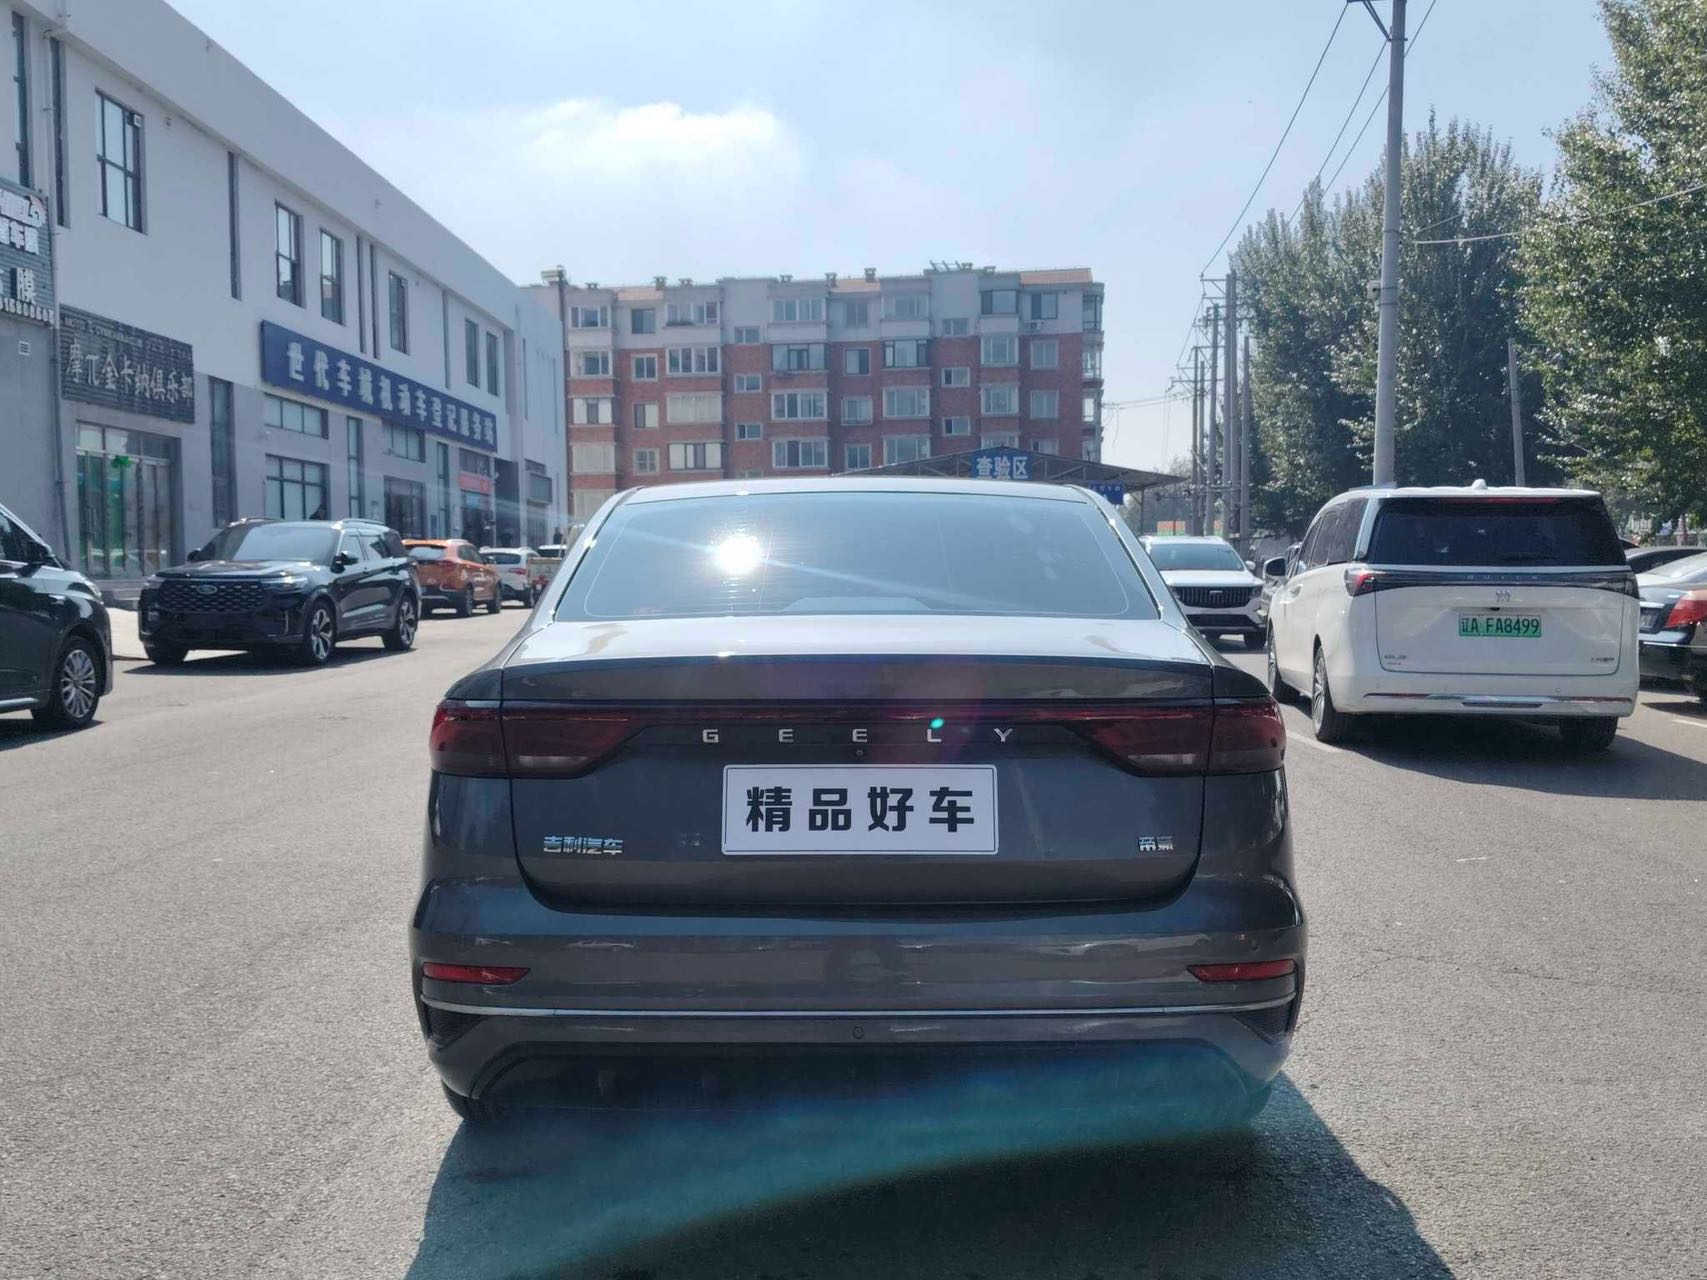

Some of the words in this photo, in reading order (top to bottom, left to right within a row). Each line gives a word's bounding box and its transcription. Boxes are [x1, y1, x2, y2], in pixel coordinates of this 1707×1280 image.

[976, 455, 1029, 480] 查验区
[702, 728, 1014, 744] GEELY
[745, 786, 975, 833] 精品好车
[543, 836, 624, 855] 吉利汽车
